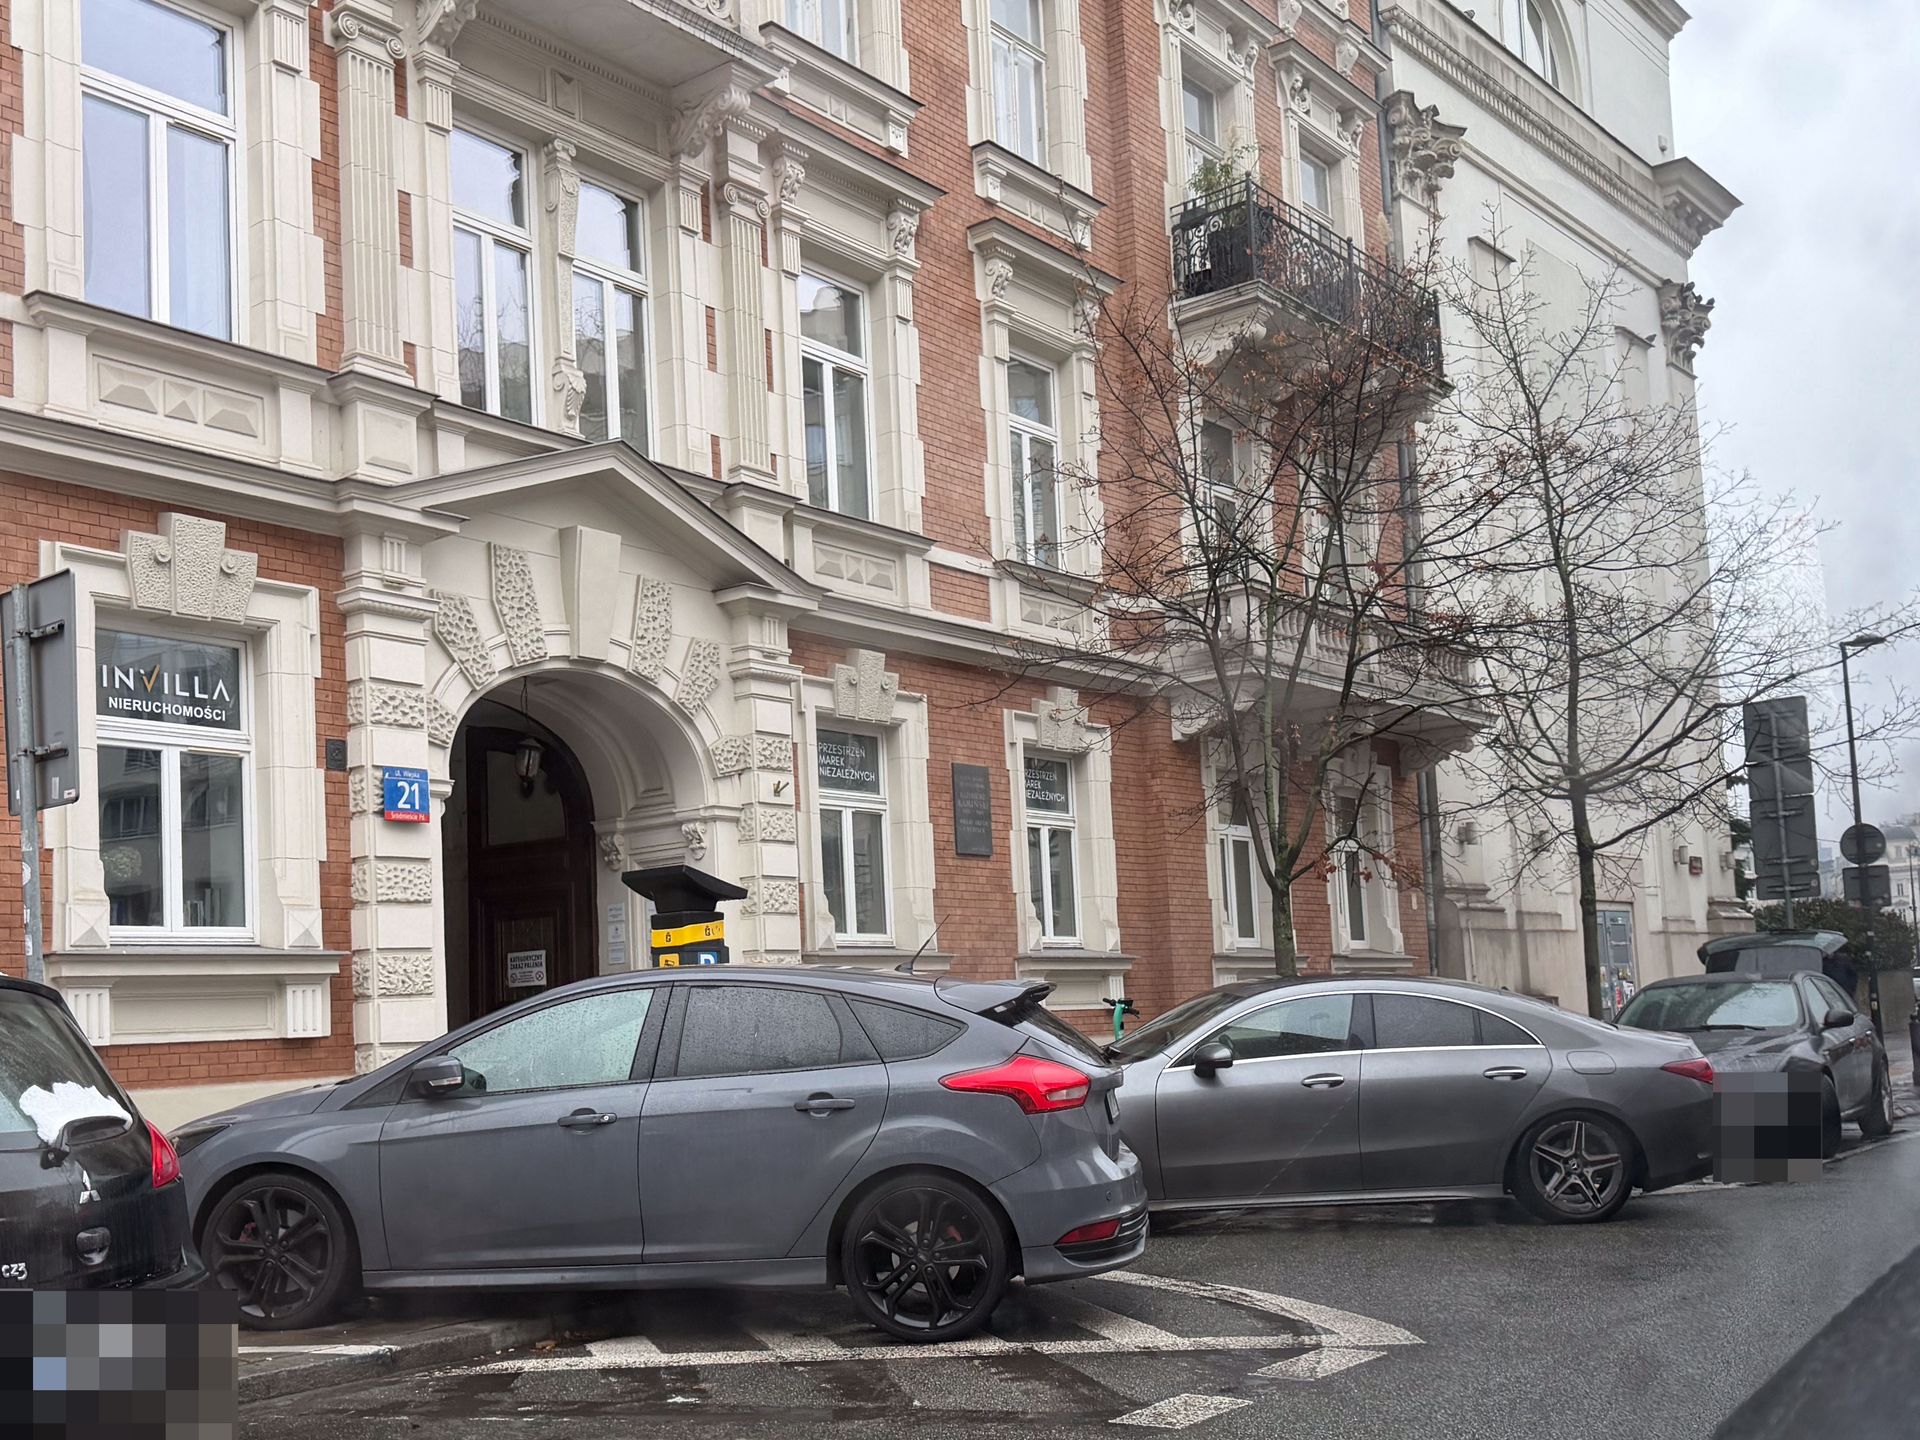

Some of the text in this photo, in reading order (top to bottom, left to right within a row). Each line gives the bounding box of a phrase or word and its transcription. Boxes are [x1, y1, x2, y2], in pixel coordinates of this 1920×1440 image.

[102, 664, 230, 702] INVILLA
[108, 696, 226, 721] NIERUCHOMOŚCI
[818, 742, 866, 758] PRZESTRZEŃ
[818, 754, 845, 767] MAREK
[819, 766, 876, 782] NIEZALEŻNYCH
[1025, 779, 1041, 790] AREK
[397, 781, 420, 810] 21
